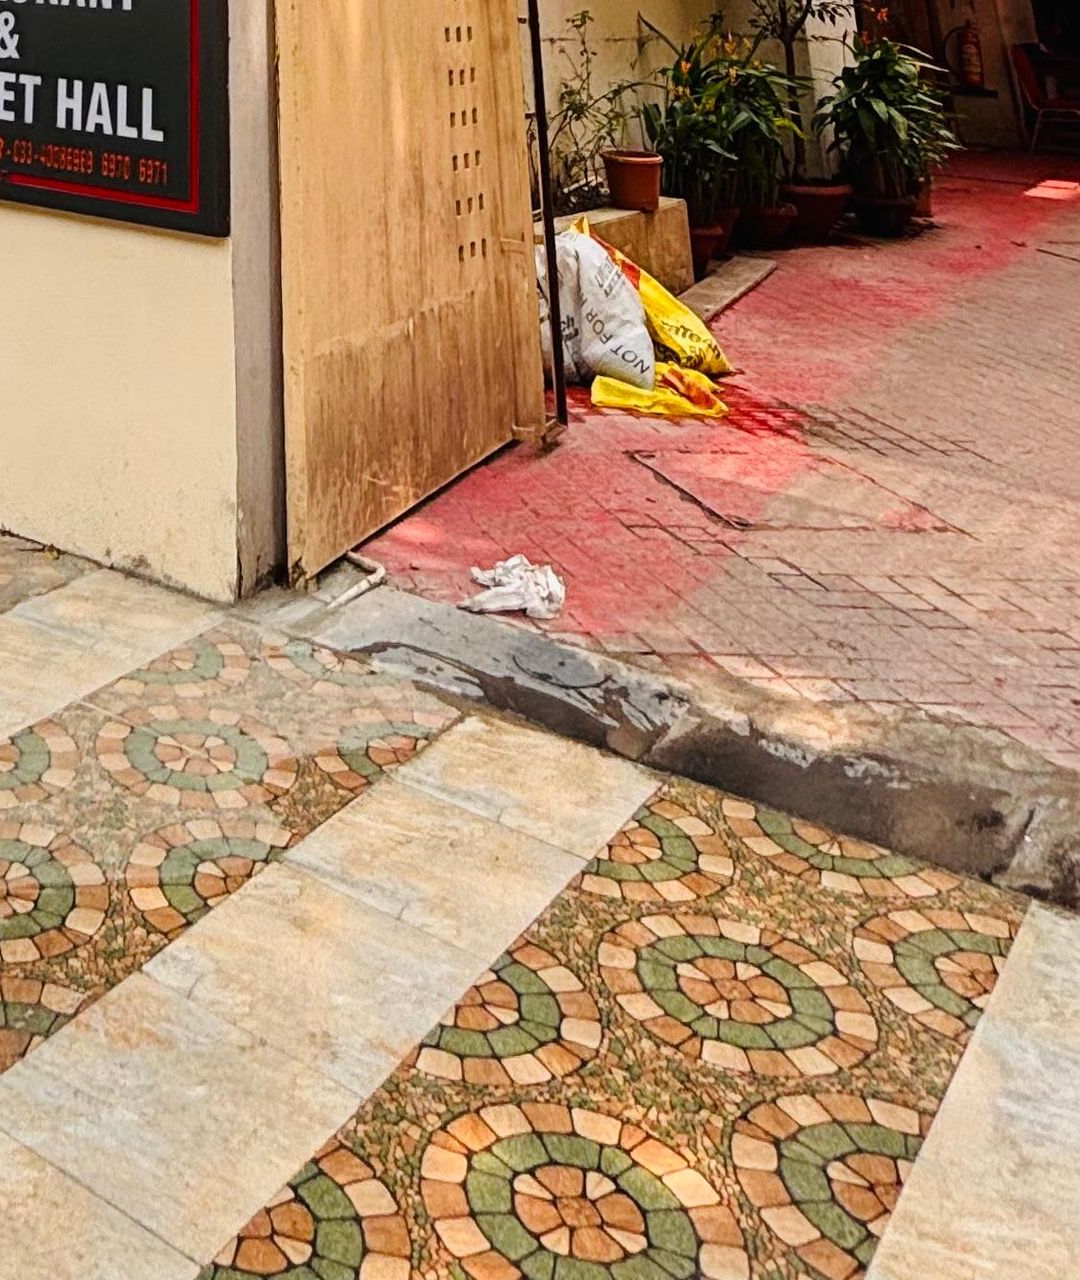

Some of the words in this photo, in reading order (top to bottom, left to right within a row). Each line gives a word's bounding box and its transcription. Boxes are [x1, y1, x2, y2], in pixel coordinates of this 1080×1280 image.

[56, 78, 164, 142] HALL
[585, 307, 613, 345] FOR
[611, 345, 650, 374] NOT
